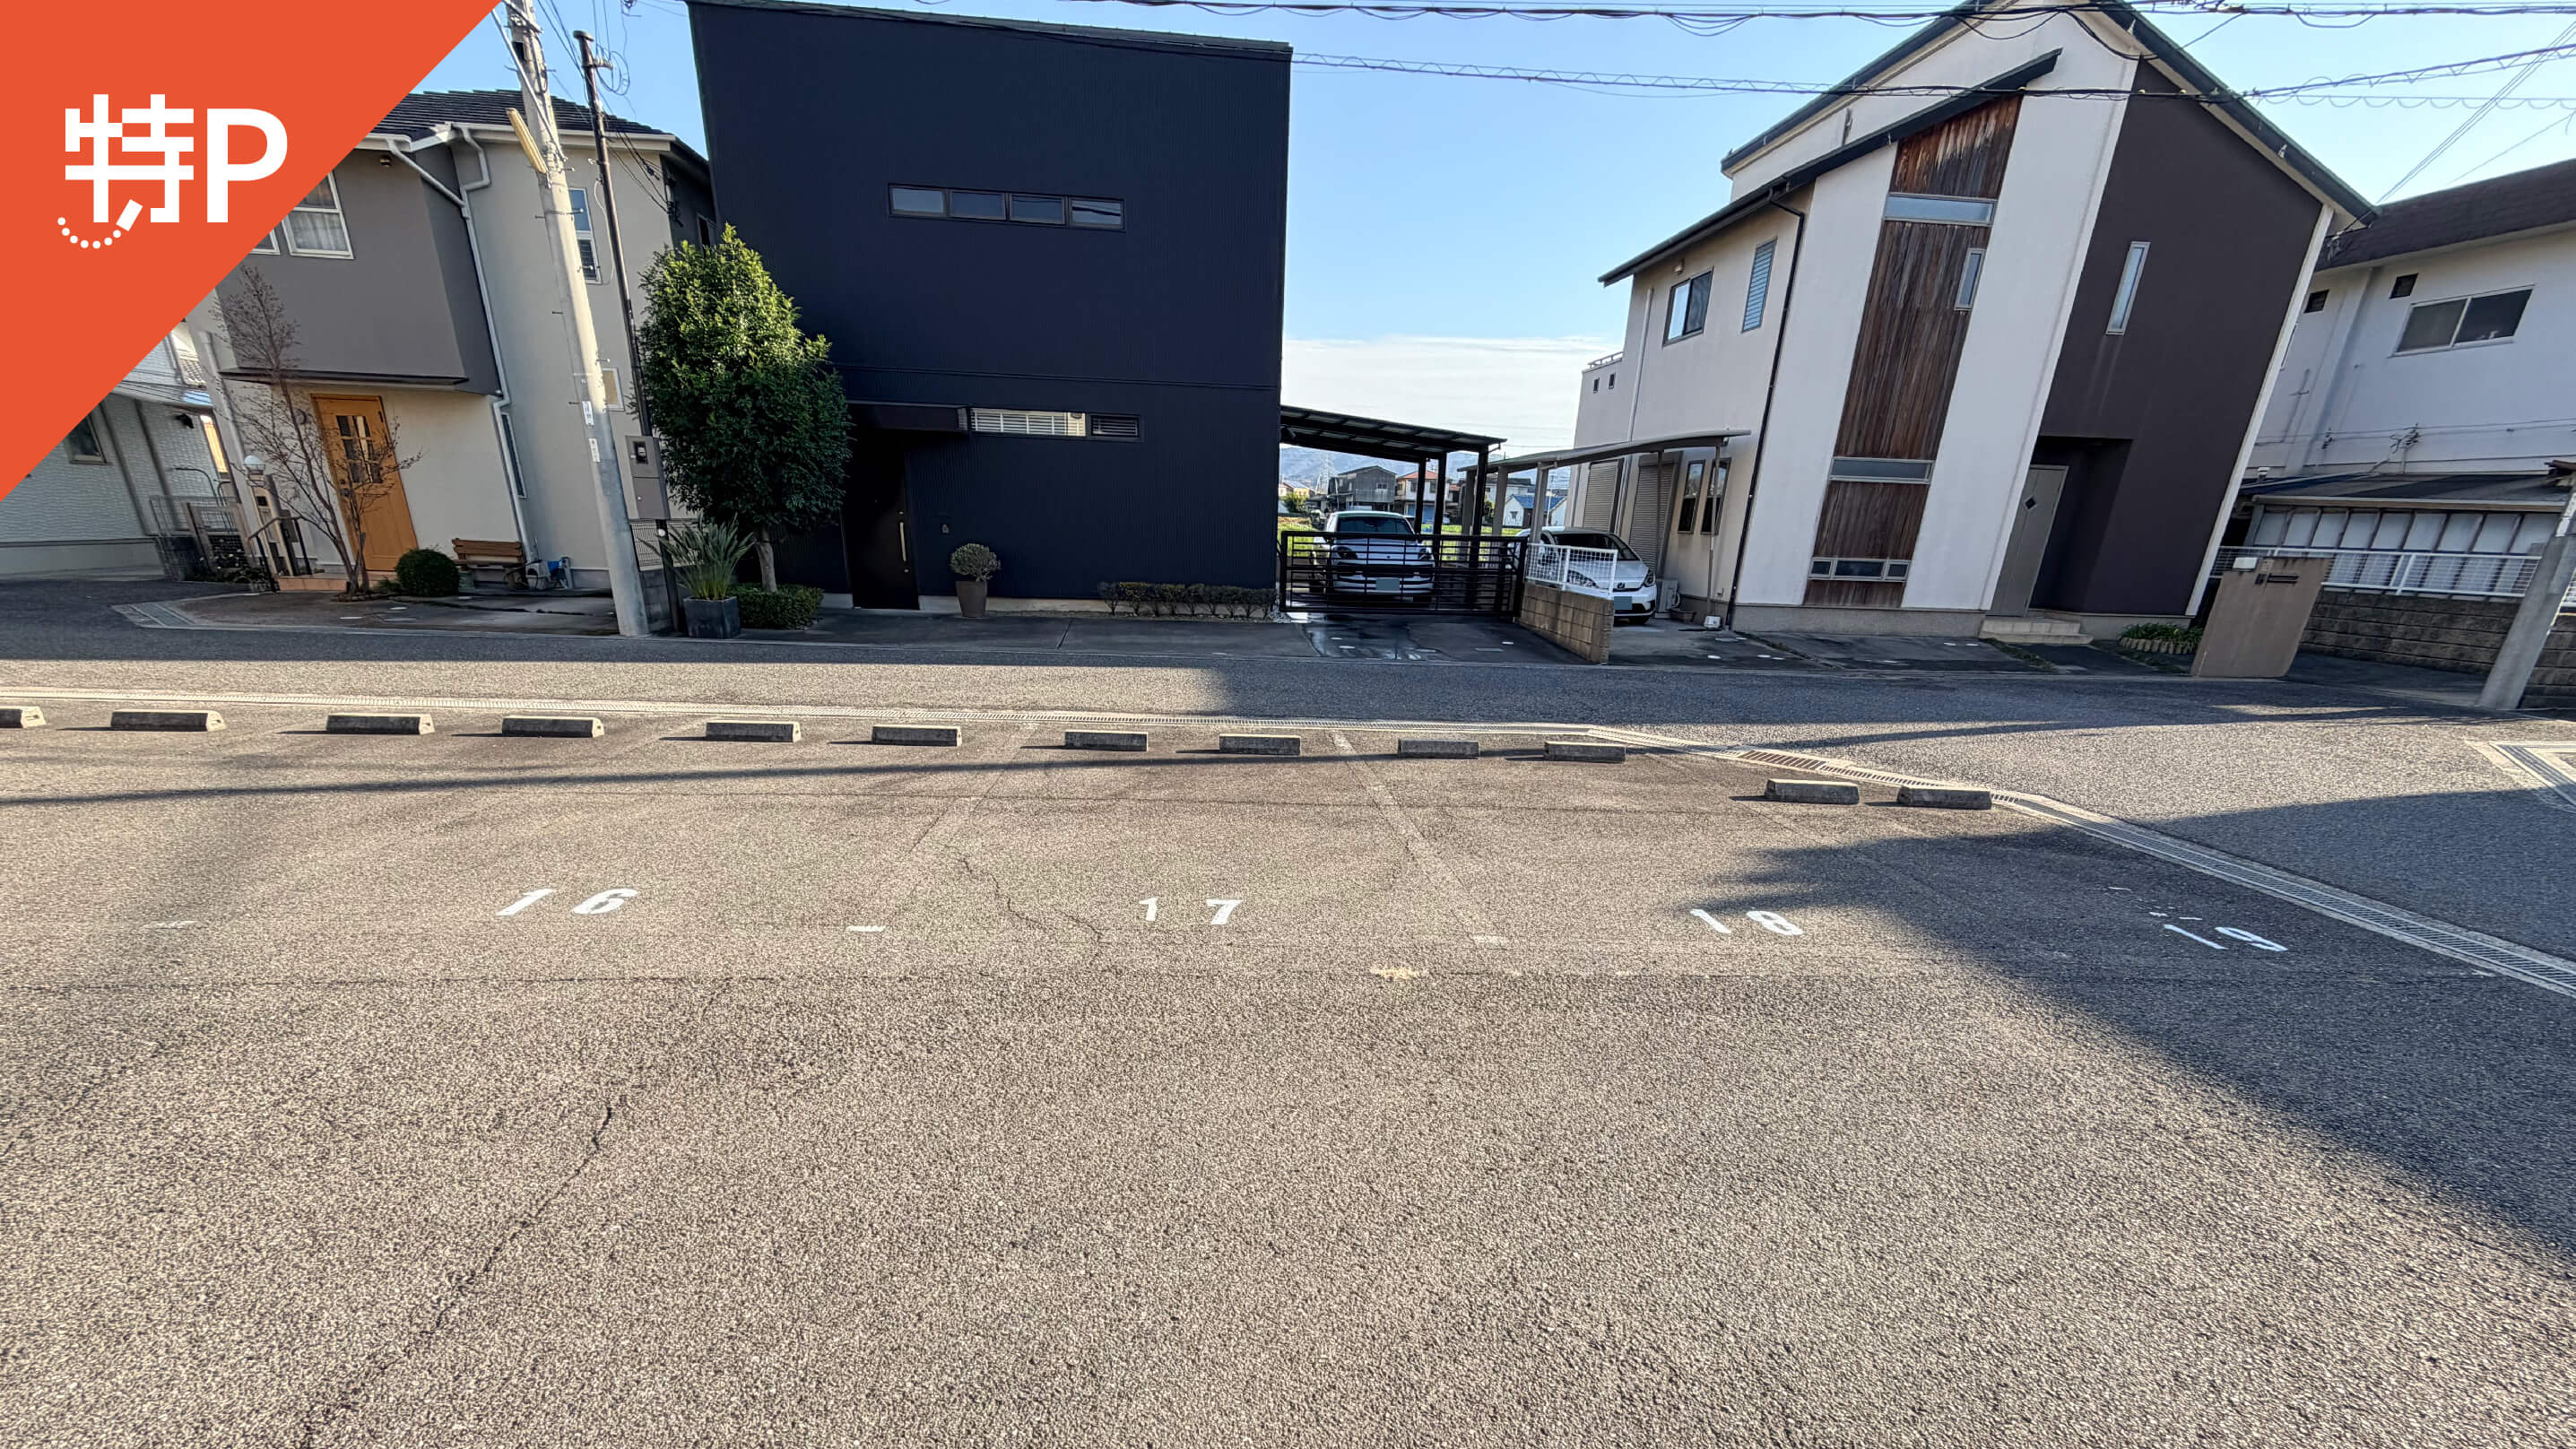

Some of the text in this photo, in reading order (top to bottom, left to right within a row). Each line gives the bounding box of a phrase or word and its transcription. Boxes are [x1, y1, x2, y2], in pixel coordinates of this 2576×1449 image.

[495, 888, 638, 915] 16
[1138, 897, 1243, 924] 17
[1689, 908, 1804, 935] 18
[2163, 924, 2288, 952] 19
